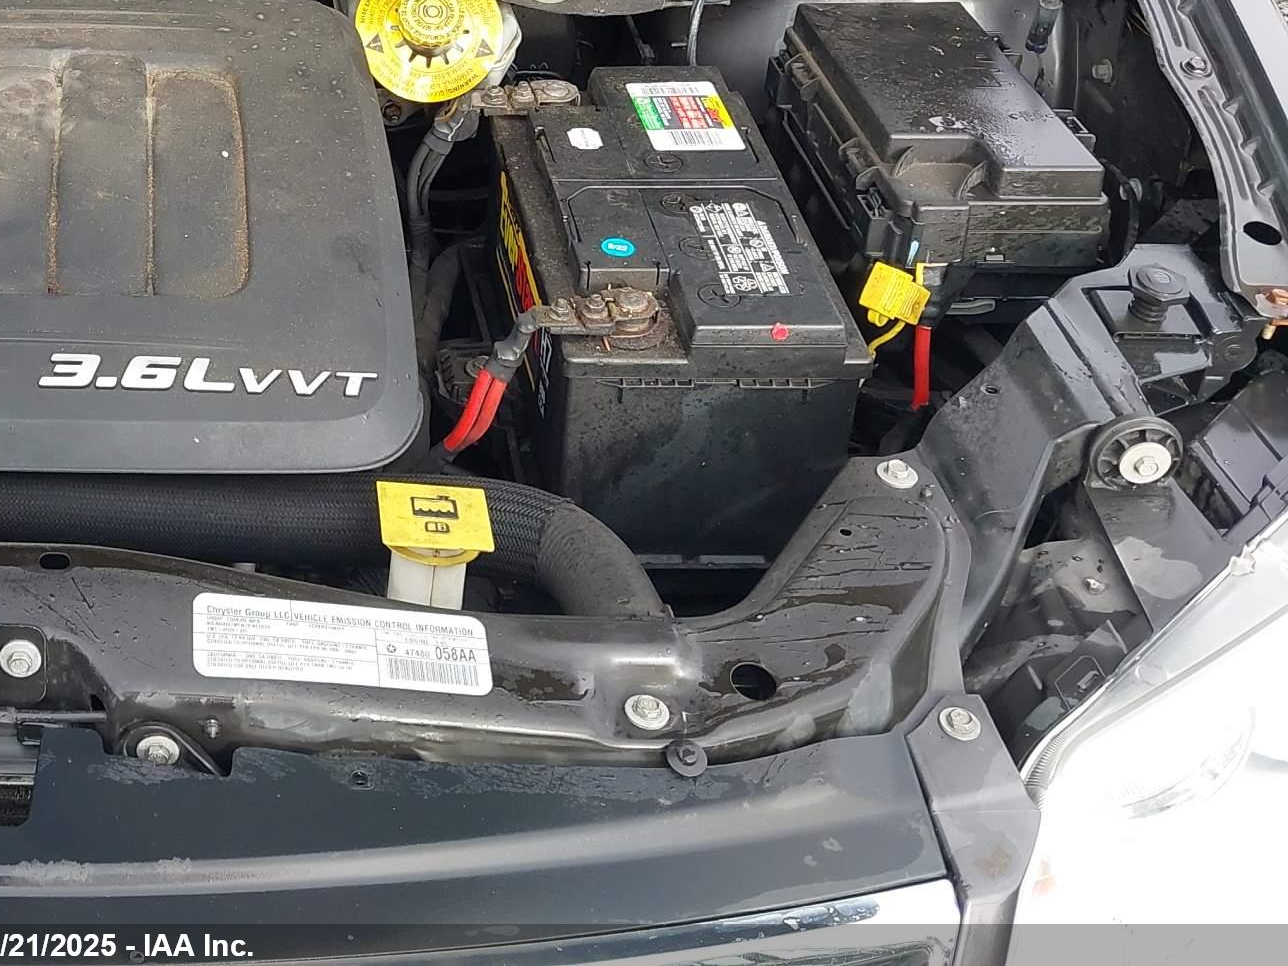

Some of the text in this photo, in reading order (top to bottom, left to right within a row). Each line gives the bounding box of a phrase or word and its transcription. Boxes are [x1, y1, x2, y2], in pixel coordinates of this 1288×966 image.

[365, 0, 371, 8] EN
[206, 605, 242, 617] Chrysler
[245, 608, 271, 619] Group
[274, 611, 290, 620] LLC
[294, 613, 328, 624] VEHICLE
[331, 615, 372, 627] EMISSION
[374, 620, 412, 631] CONTROL
[415, 623, 474, 636] INFORMATION
[435, 645, 478, 663] 058AA
